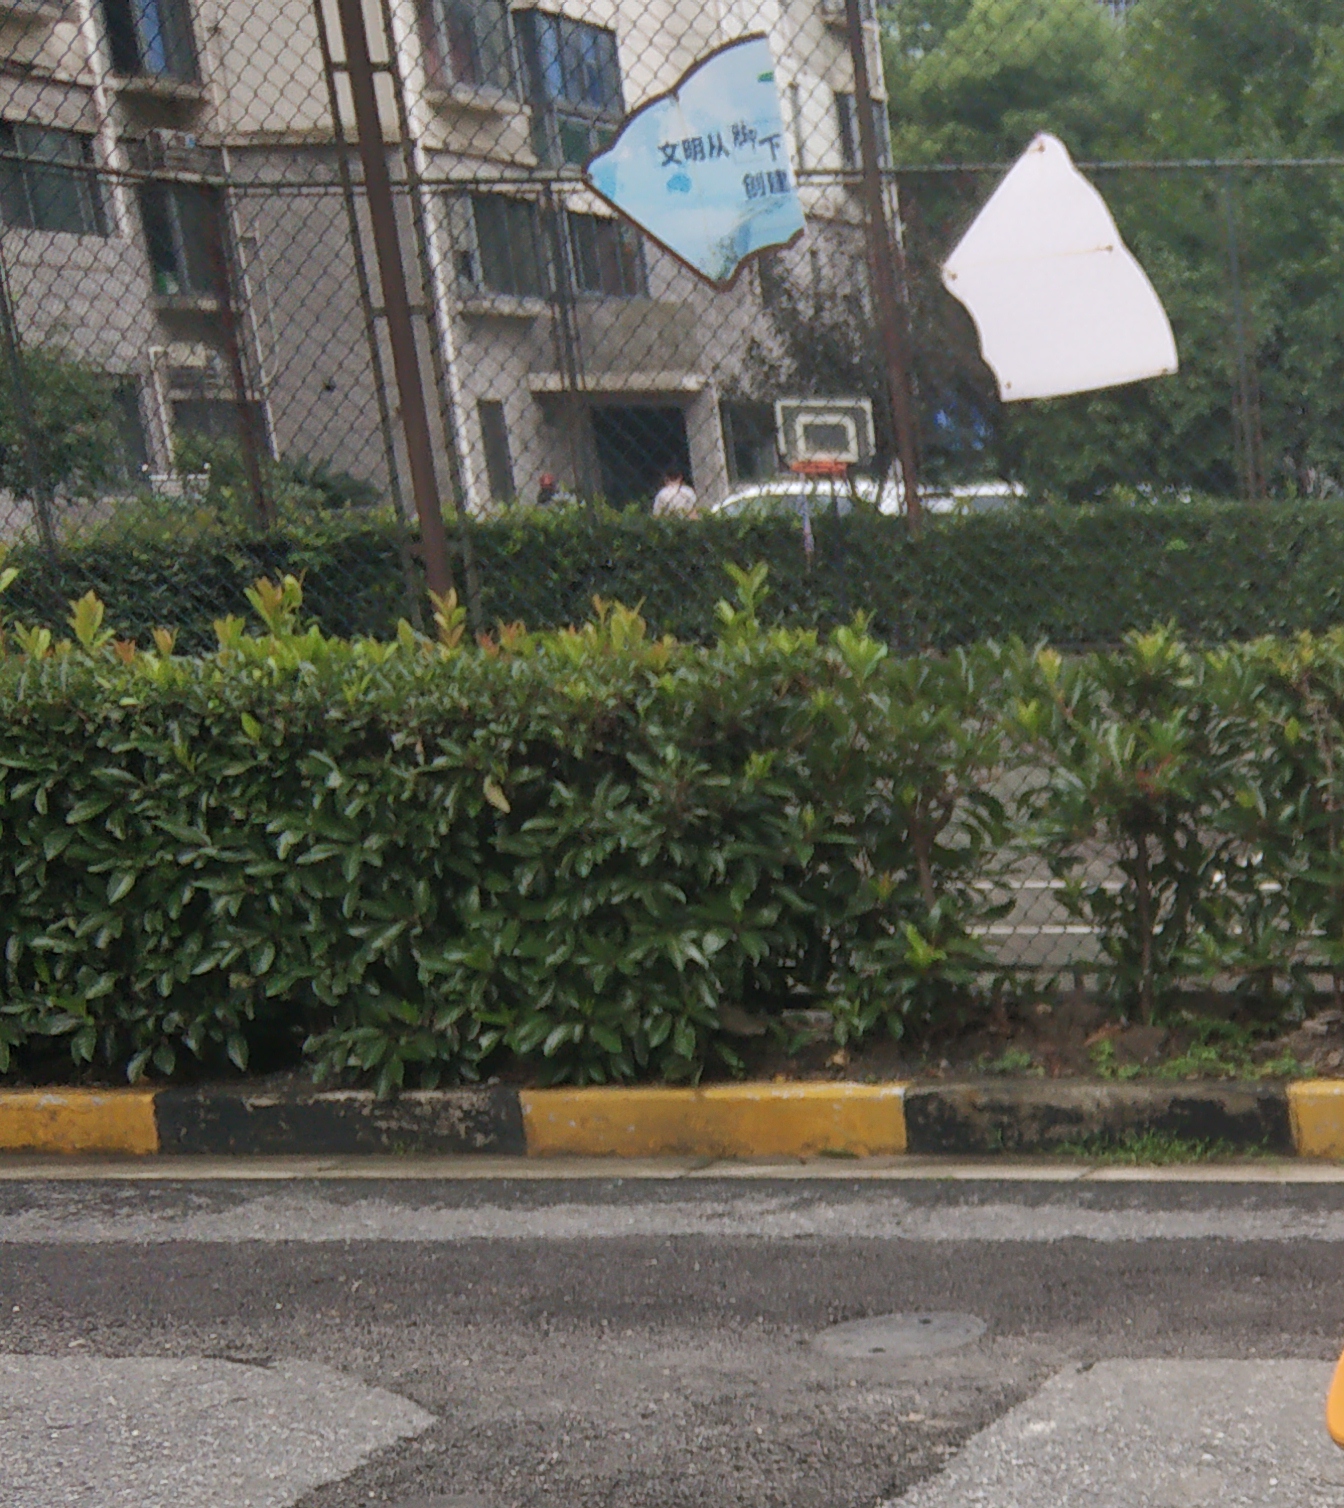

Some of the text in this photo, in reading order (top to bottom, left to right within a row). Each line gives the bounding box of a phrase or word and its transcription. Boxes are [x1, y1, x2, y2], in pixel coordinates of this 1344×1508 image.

[657, 121, 782, 167] 文明从脚下
